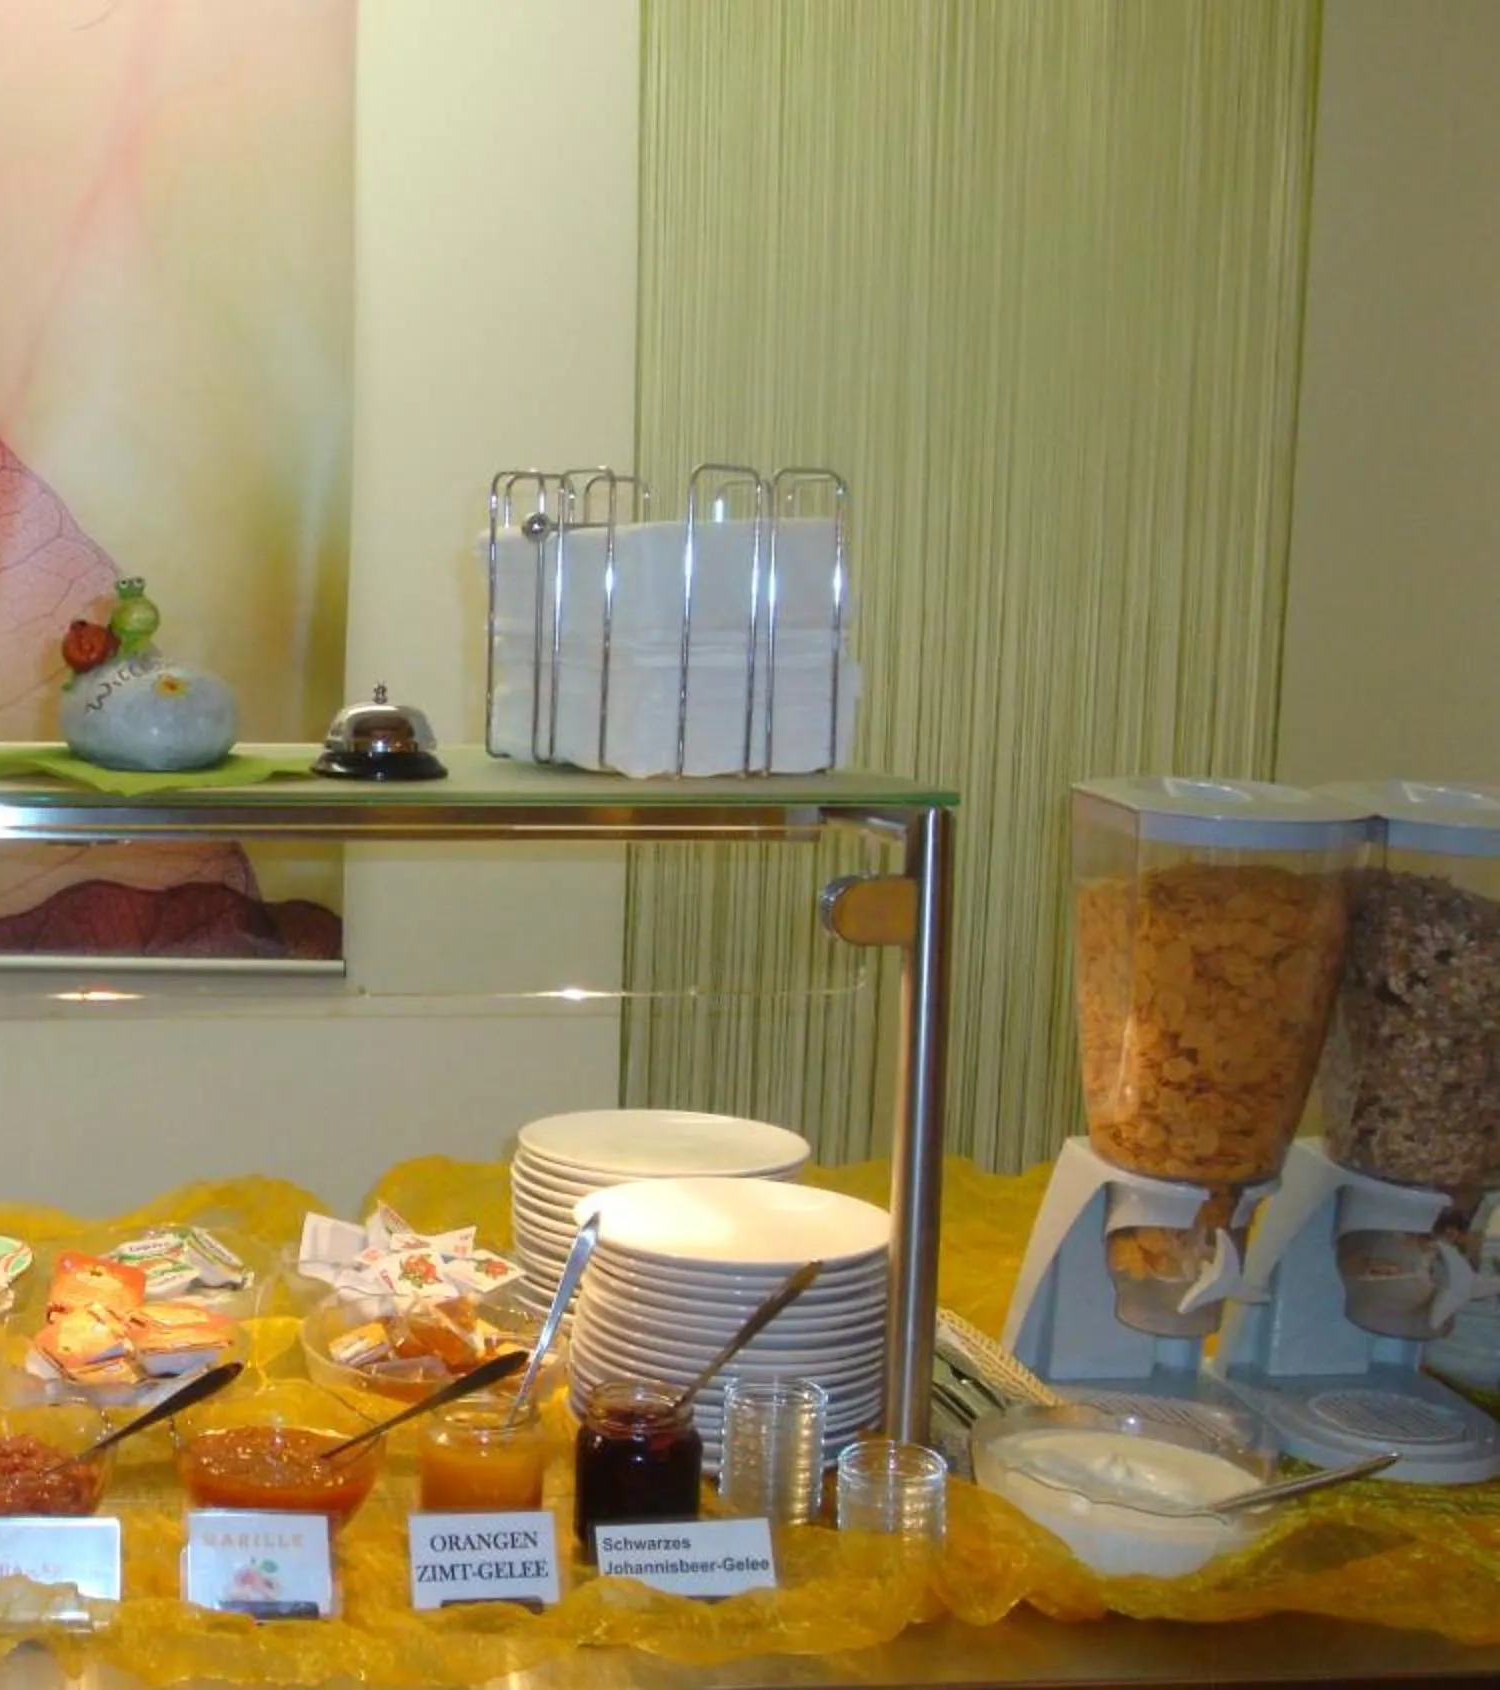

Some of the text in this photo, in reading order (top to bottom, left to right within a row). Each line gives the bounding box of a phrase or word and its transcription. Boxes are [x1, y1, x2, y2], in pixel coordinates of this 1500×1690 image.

[429, 1531, 538, 1552] ORANGEN
[602, 1536, 692, 1552] Schwarzes
[416, 1560, 549, 1583] ZIMT-GELEE
[603, 1556, 770, 1576] Johannisbeer-Gelee
